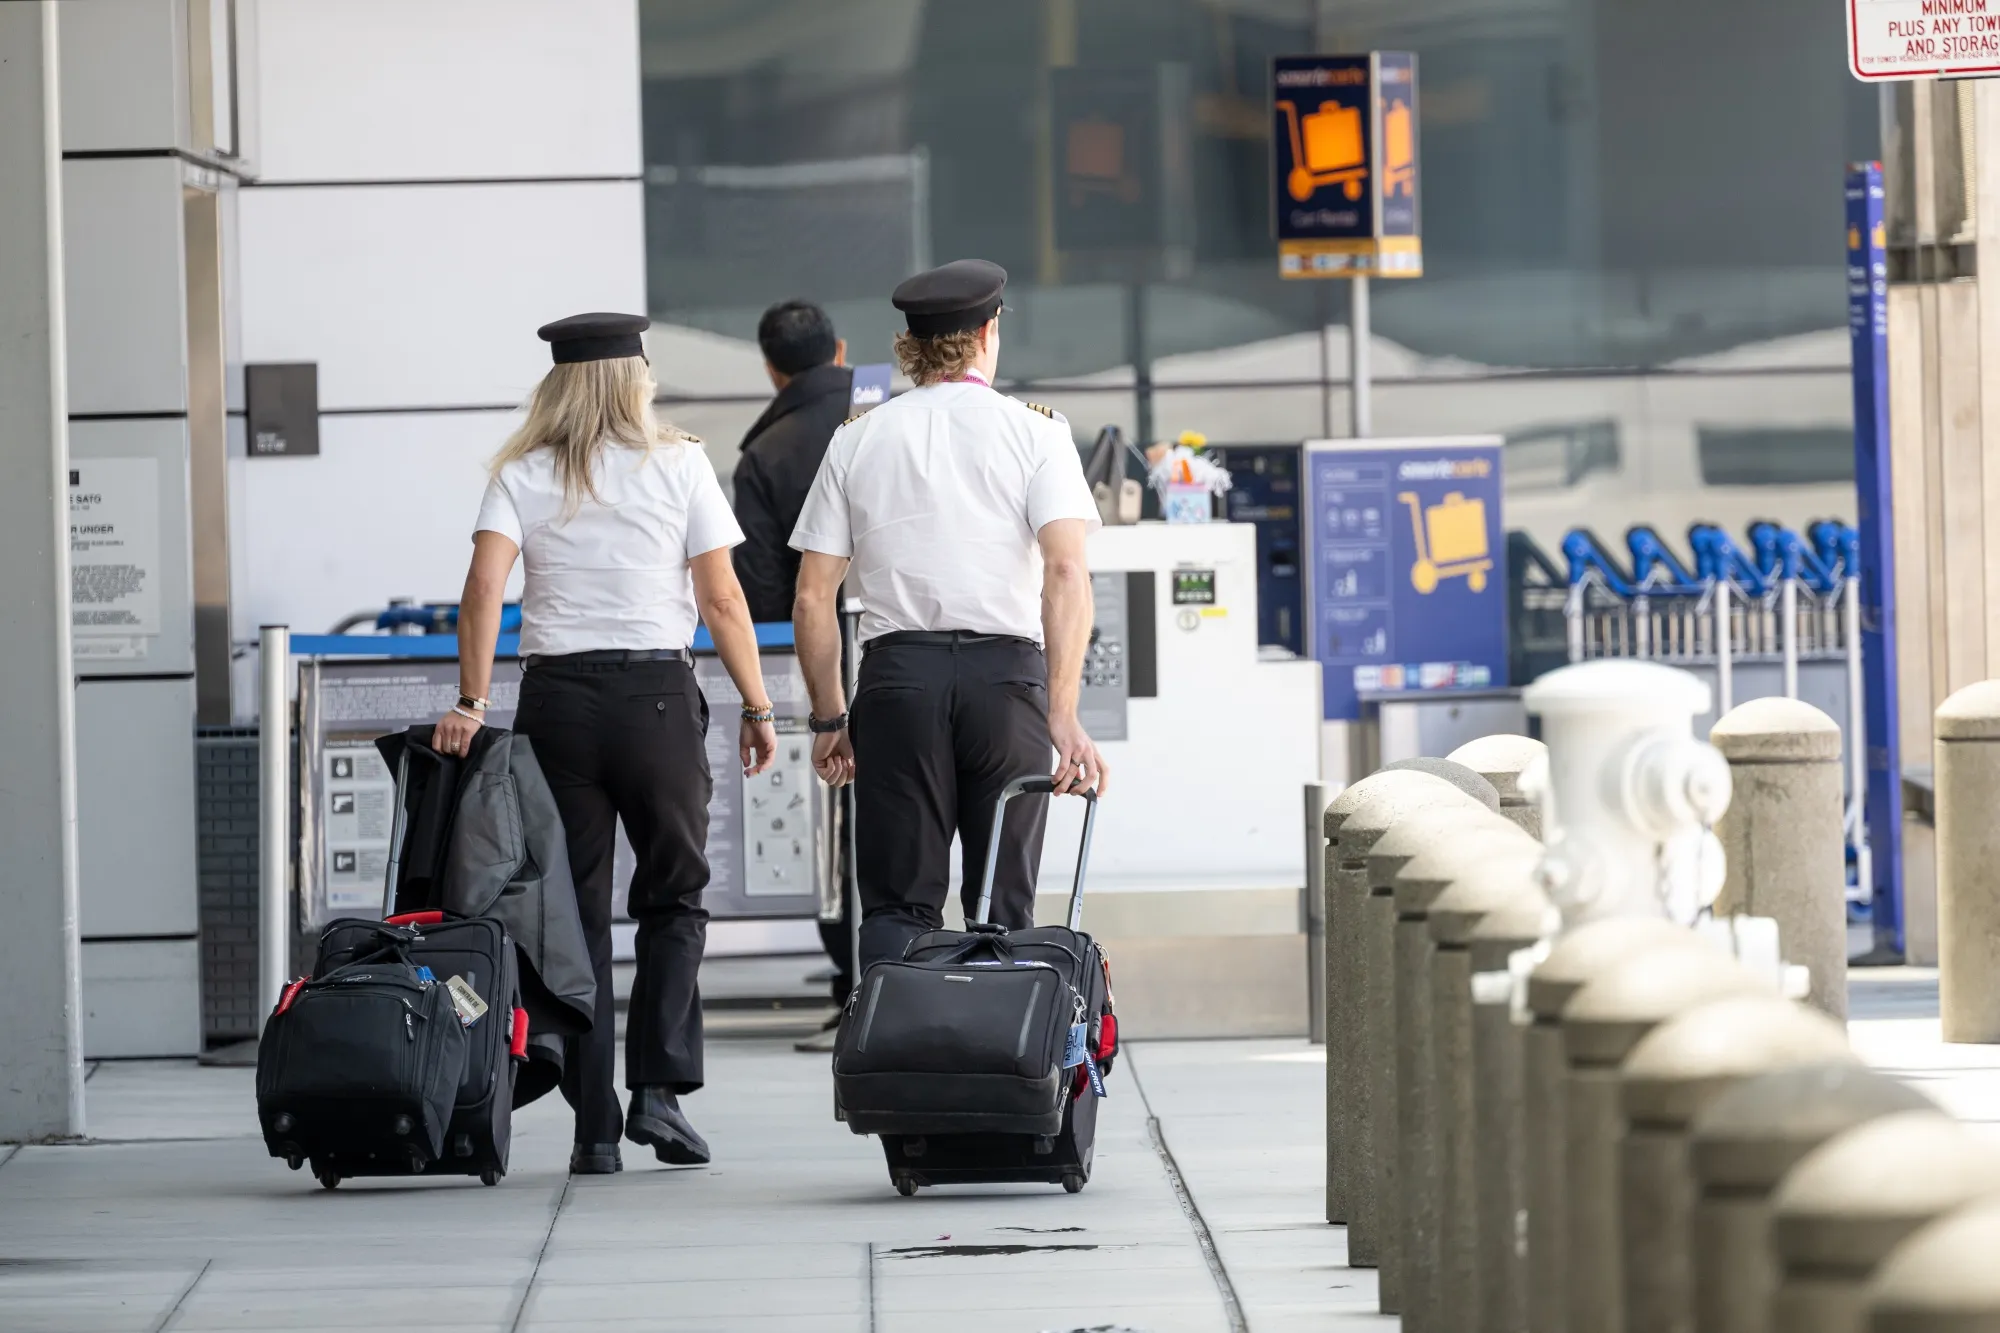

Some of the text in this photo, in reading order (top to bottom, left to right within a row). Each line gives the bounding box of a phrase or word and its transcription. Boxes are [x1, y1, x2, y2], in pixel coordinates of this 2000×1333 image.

[1922, 0, 1986, 15] MINIMUM
[1888, 20, 1925, 37] PLUS
[1933, 17, 1961, 34] ANY
[1906, 34, 2000, 56] AND STORAG
[80, 524, 114, 535] UNDER
[1091, 1070, 1102, 1094] CREW
